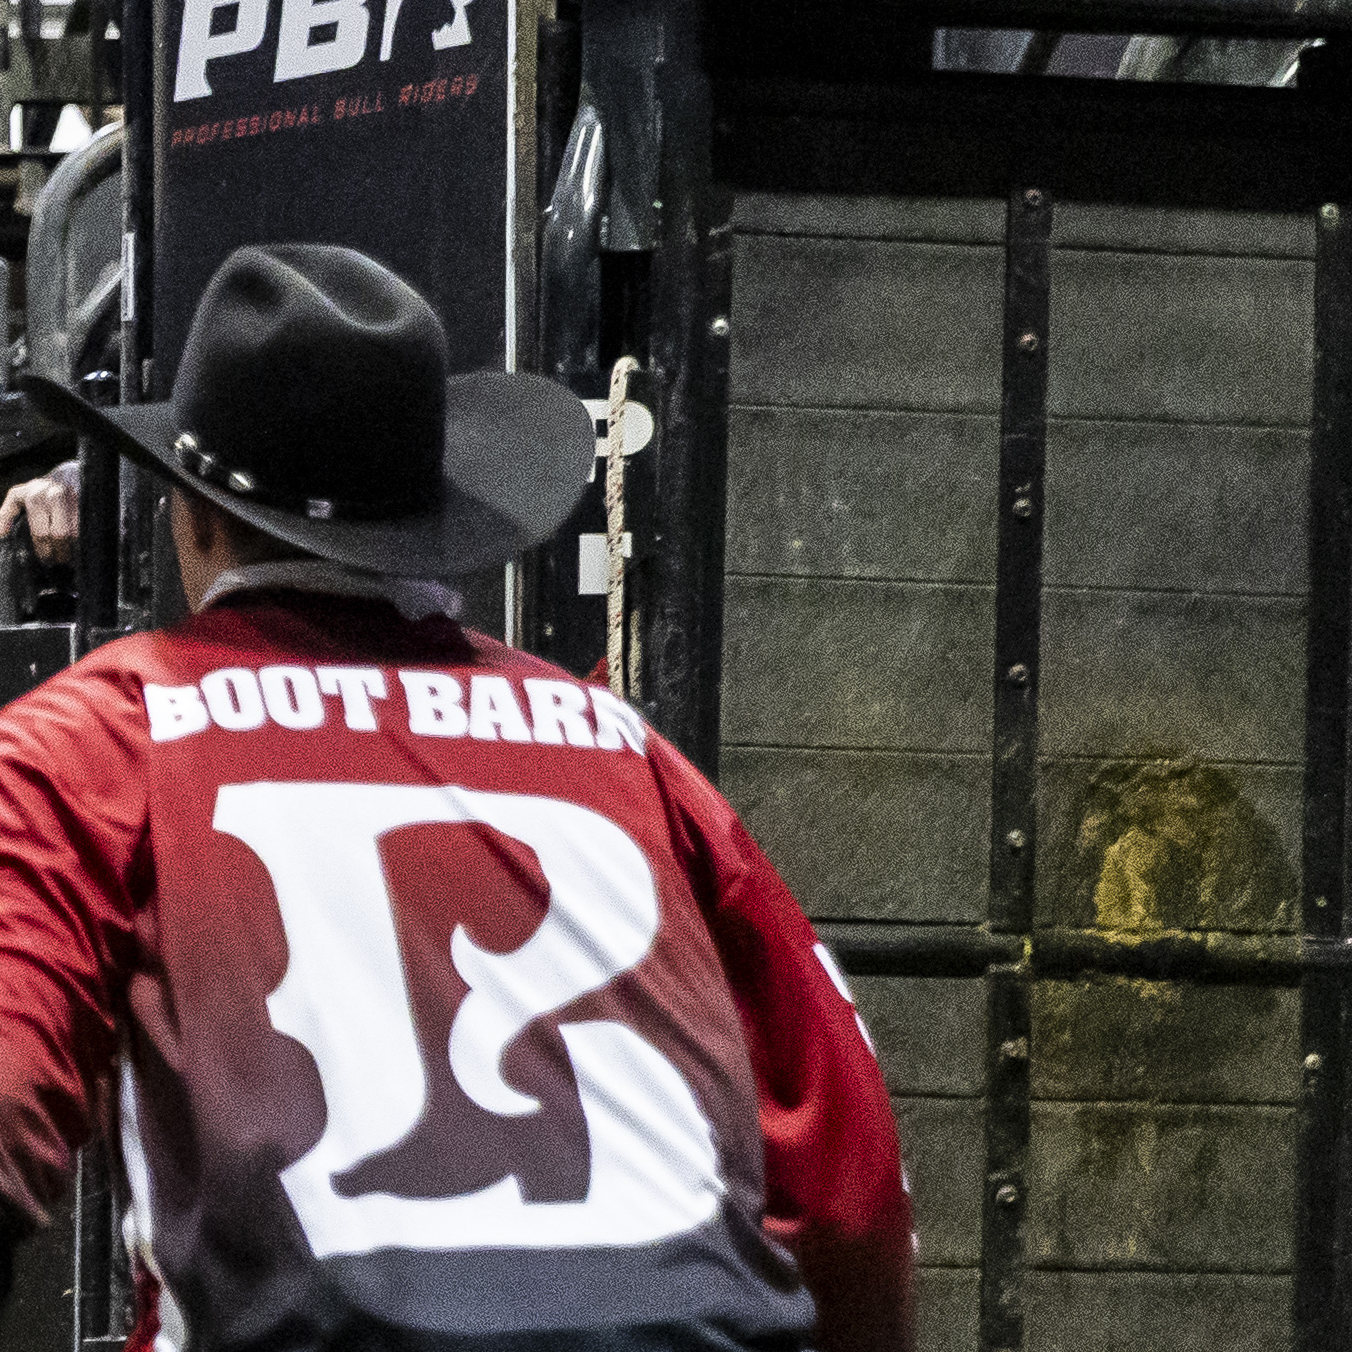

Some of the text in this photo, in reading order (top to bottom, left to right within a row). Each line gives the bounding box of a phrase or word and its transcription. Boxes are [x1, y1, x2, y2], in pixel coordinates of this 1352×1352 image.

[333, 92, 383, 121] BULL
[397, 73, 479, 105] RIDERS
[144, 665, 387, 743] BOOT
